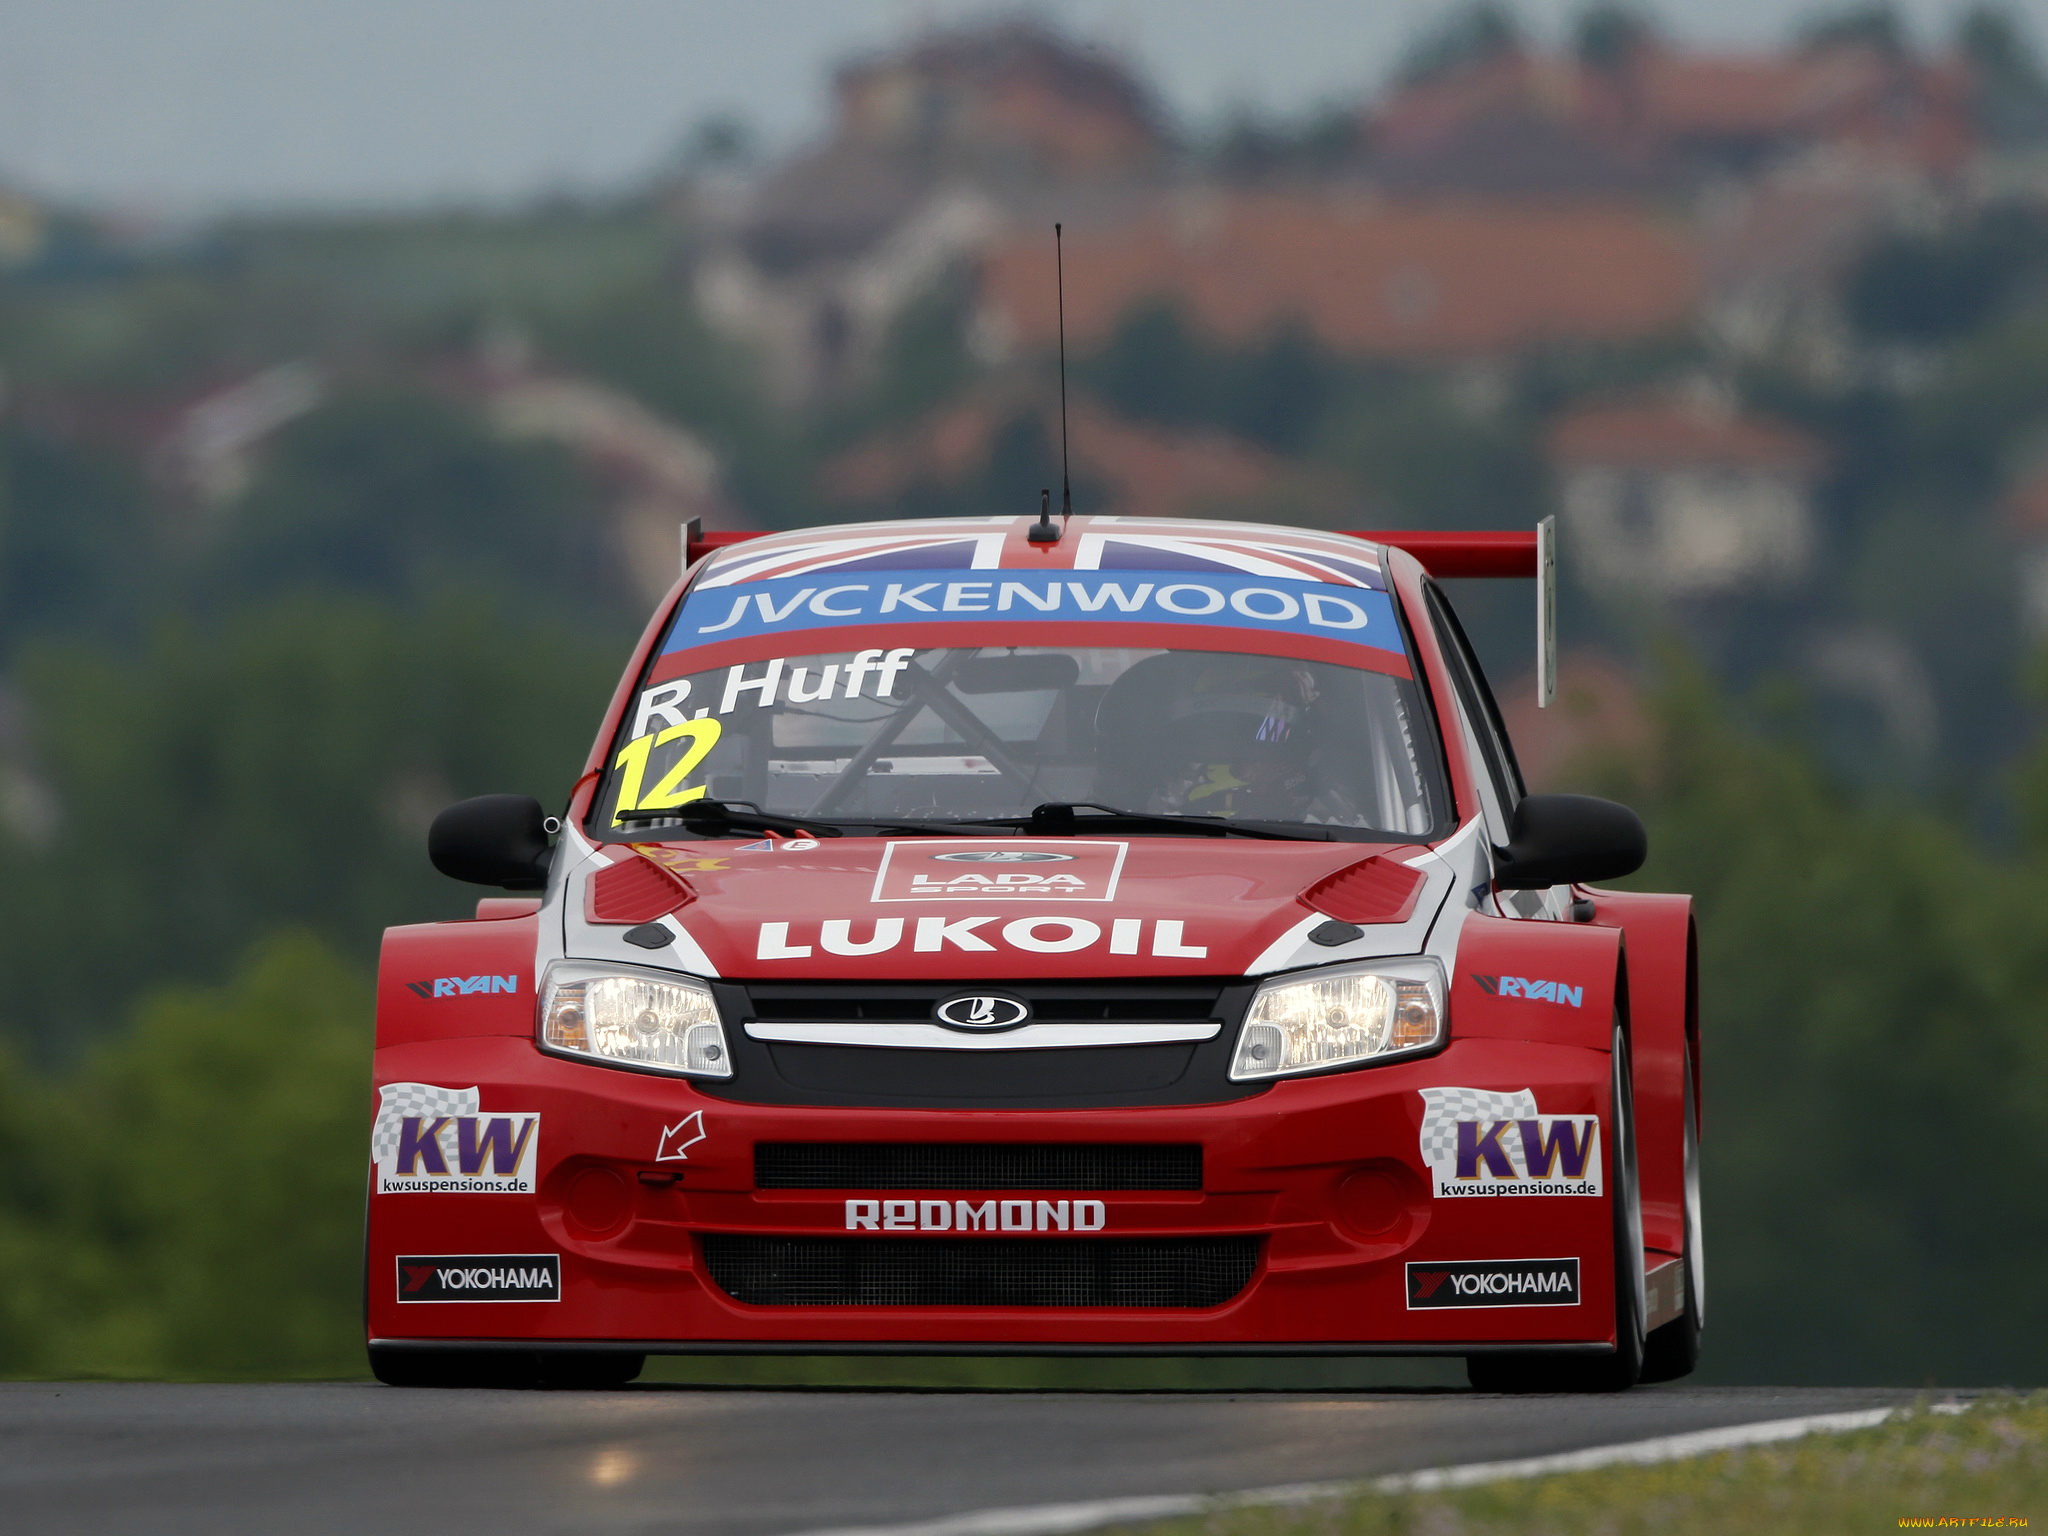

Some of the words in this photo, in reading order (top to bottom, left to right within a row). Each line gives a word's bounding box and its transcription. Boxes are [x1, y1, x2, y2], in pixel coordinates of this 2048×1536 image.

[611, 717, 722, 828] 12
[912, 873, 1086, 885] LADA
[756, 916, 1208, 960] LUKOIL
[433, 975, 518, 998] RYAN
[1498, 976, 1583, 1008] RYAN
[396, 1117, 538, 1176] KW
[1455, 1120, 1598, 1180] KW
[383, 1178, 529, 1193] kwsuspensions.de
[1440, 1181, 1597, 1197] kwsuspensions.de
[436, 1268, 553, 1288] YOKOHAMA
[1450, 1272, 1573, 1295] YOKOHAMA
